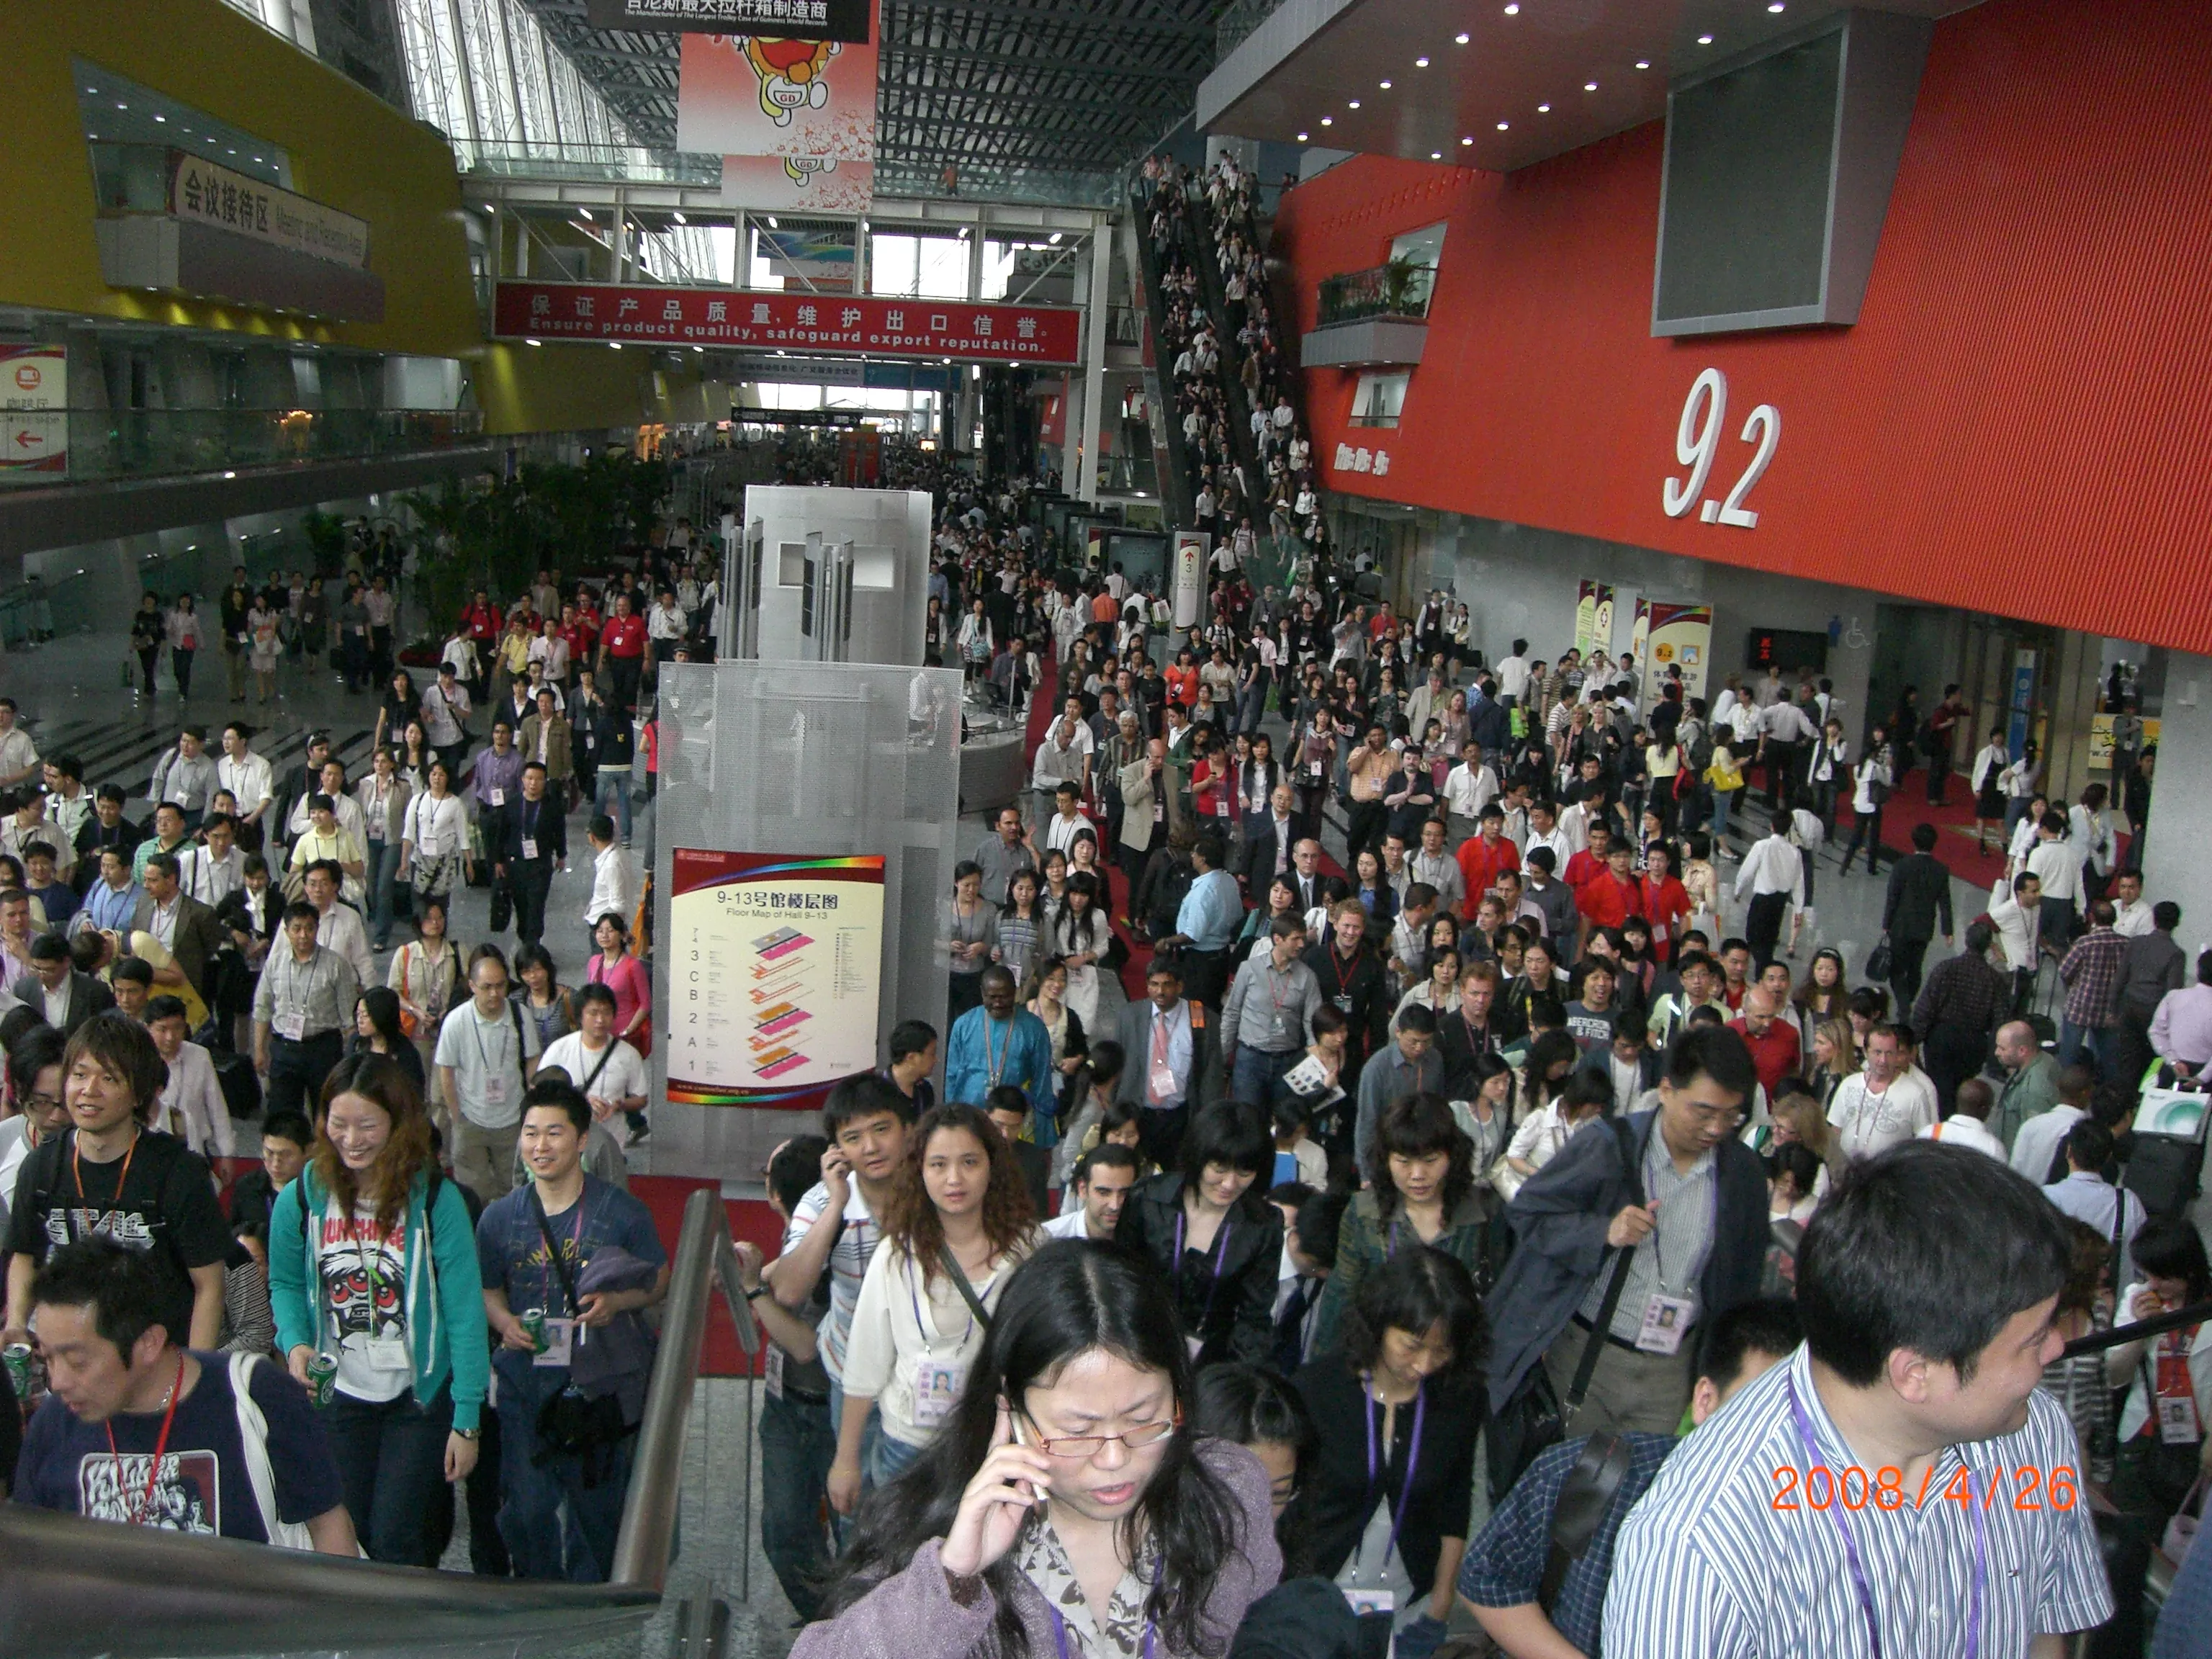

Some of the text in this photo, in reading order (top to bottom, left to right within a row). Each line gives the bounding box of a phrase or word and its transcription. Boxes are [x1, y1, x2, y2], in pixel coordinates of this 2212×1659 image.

[185, 168, 269, 233] 会议接待区
[530, 318, 1046, 353] Ensure product quality, safeguard export reputation.
[1663, 367, 1781, 529] 9.2
[1185, 564, 1193, 573] 3
[1656, 648, 1673, 658] 9.2
[727, 907, 749, 917] Floor
[752, 909, 772, 919] Map
[774, 909, 783, 918] of
[784, 911, 802, 920] Hall
[691, 950, 699, 961] 3
[690, 971, 699, 982] C
[689, 989, 698, 1000] B
[689, 1012, 698, 1024] 2
[688, 1037, 697, 1048] A
[688, 1060, 694, 1071] 1
